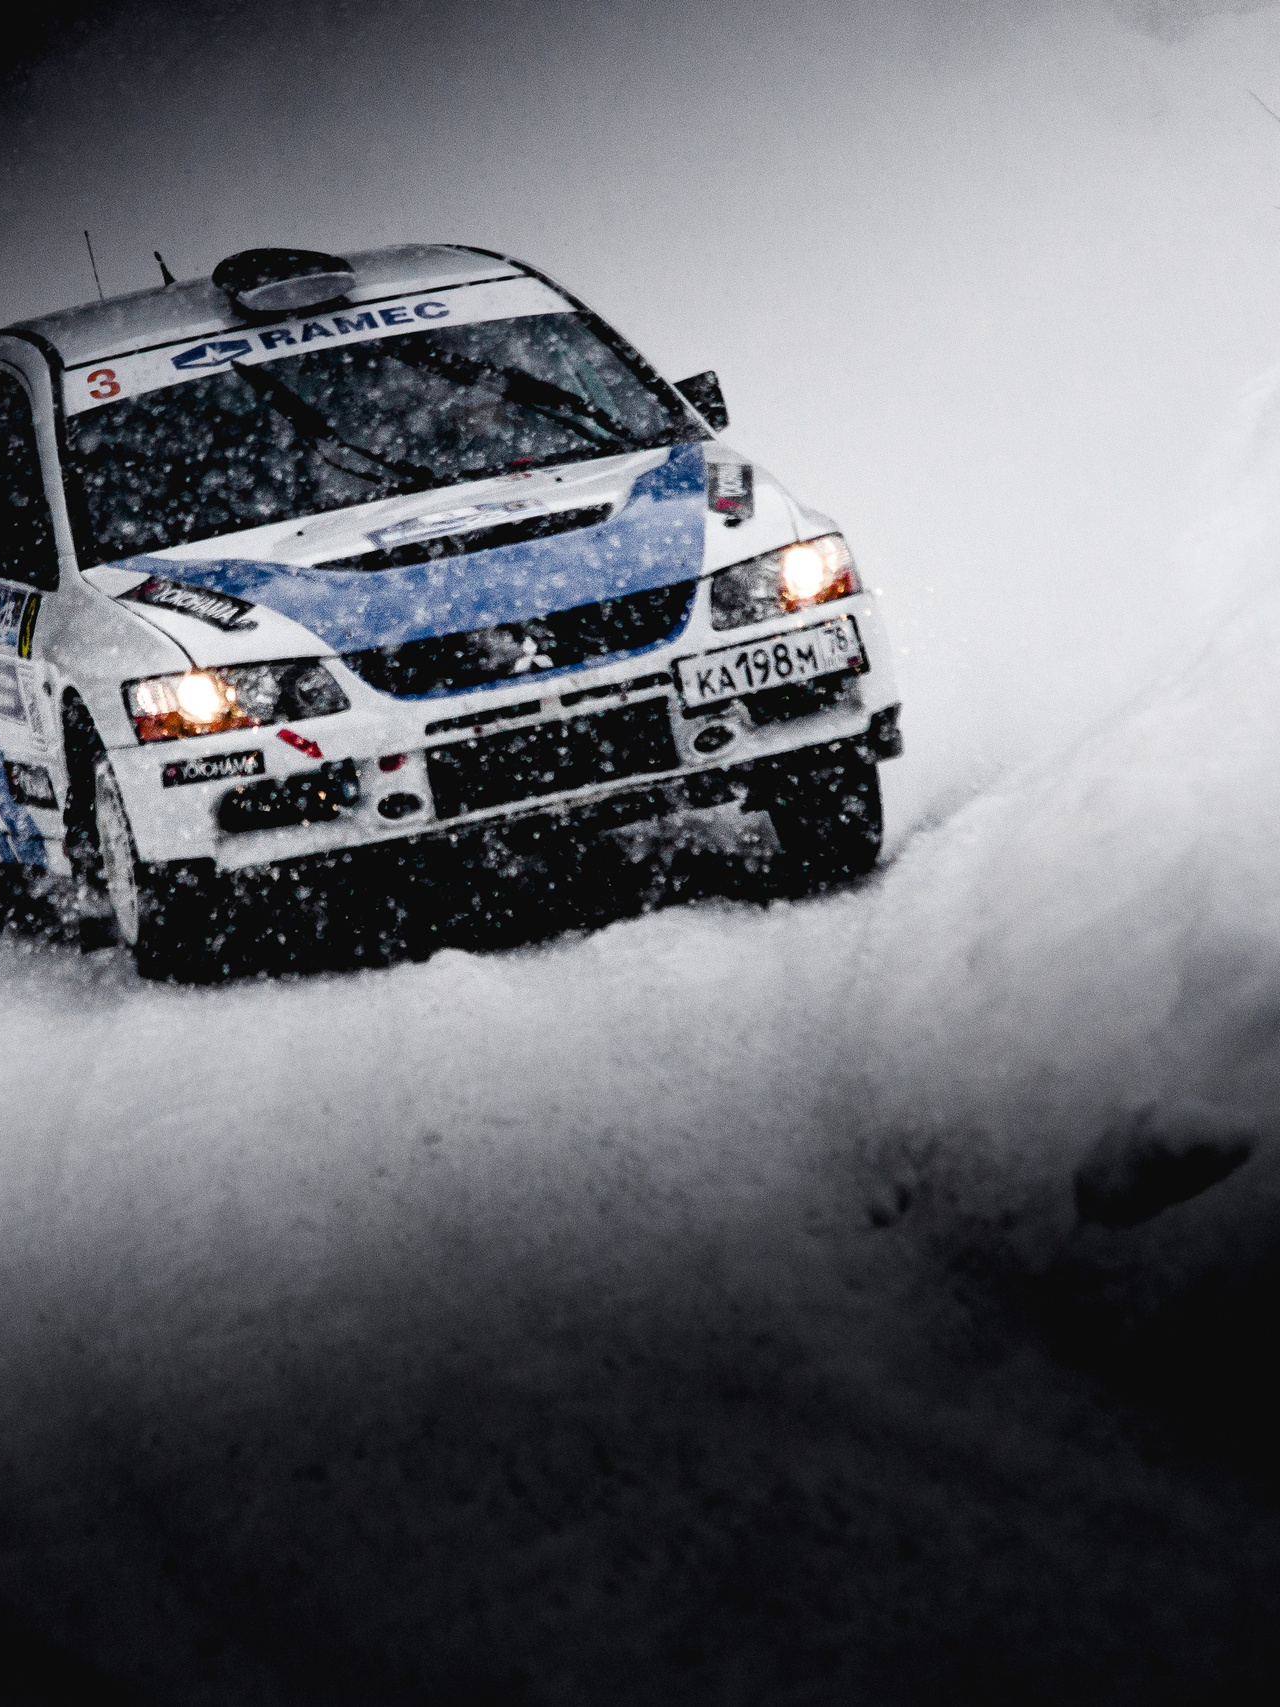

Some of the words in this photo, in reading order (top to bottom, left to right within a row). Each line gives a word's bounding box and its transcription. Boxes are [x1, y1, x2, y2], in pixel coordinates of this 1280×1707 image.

[258, 302, 450, 350] RAMEC
[87, 368, 121, 399] 3
[180, 755, 259, 780] YOKOHAMA
